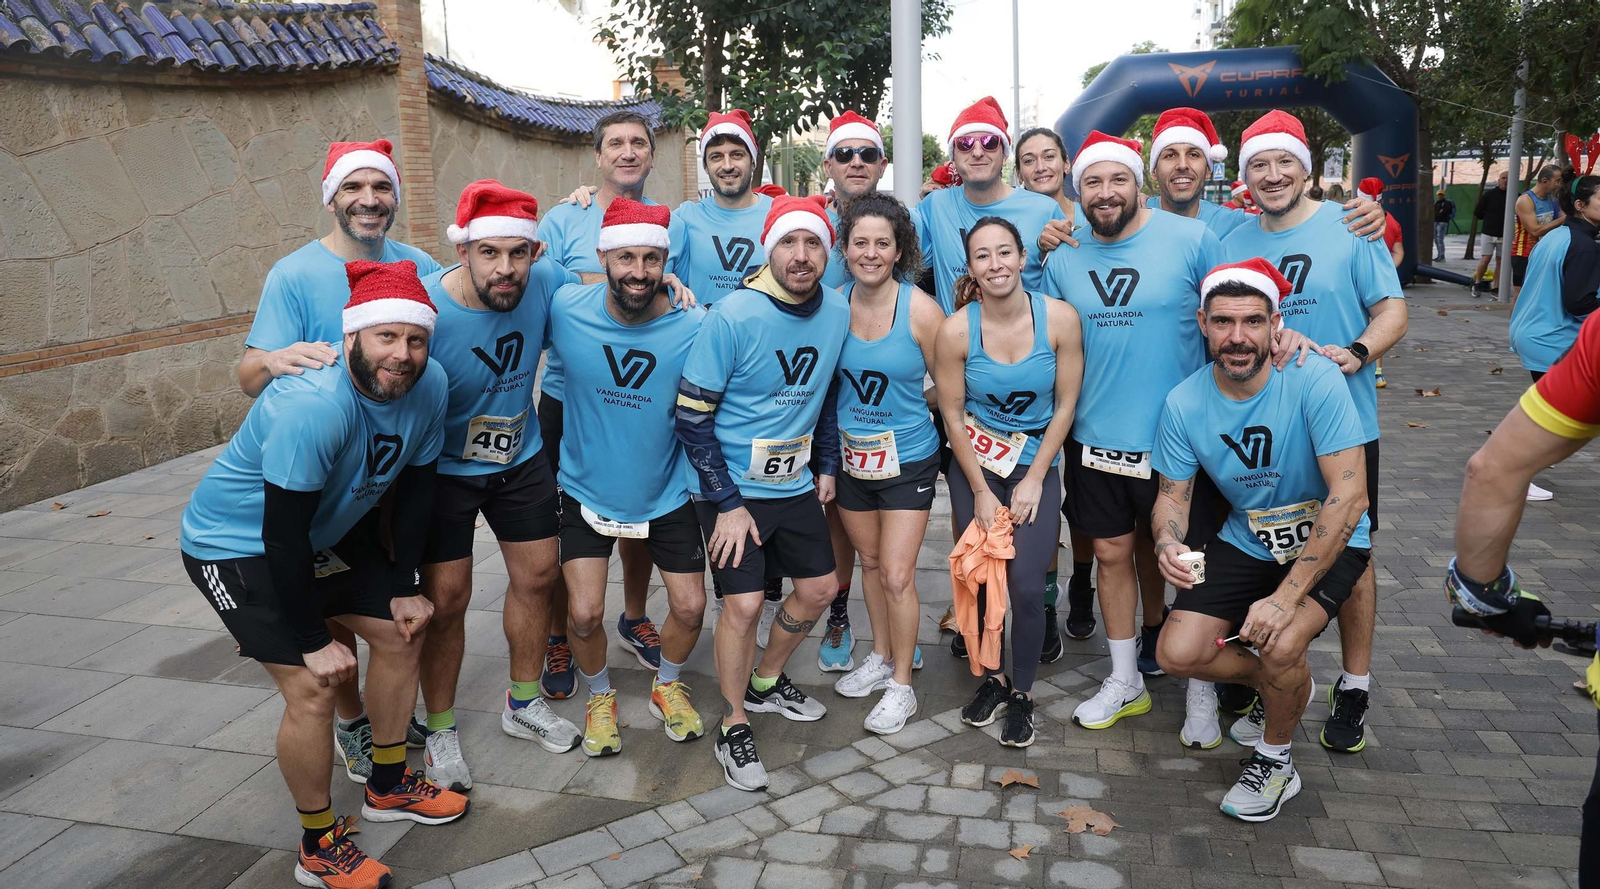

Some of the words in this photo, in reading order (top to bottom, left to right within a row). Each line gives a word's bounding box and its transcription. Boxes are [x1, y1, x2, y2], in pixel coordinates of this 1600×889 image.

[1225, 86, 1302, 98] TURIAL
[1279, 298, 1318, 309] GUARDIA
[1087, 311, 1144, 320] VANGUARDIA
[1096, 319, 1134, 328] NATURAL
[595, 387, 653, 403] VANGUARDIA
[603, 397, 642, 410] NATURAL
[849, 406, 893, 418] VANGUARDIA
[853, 415, 886, 425] NATURAL
[472, 426, 523, 452] 405
[844, 446, 887, 469] 277
[764, 455, 796, 475] 61
[1256, 520, 1314, 551] 350
[511, 714, 549, 738] BROOKS
